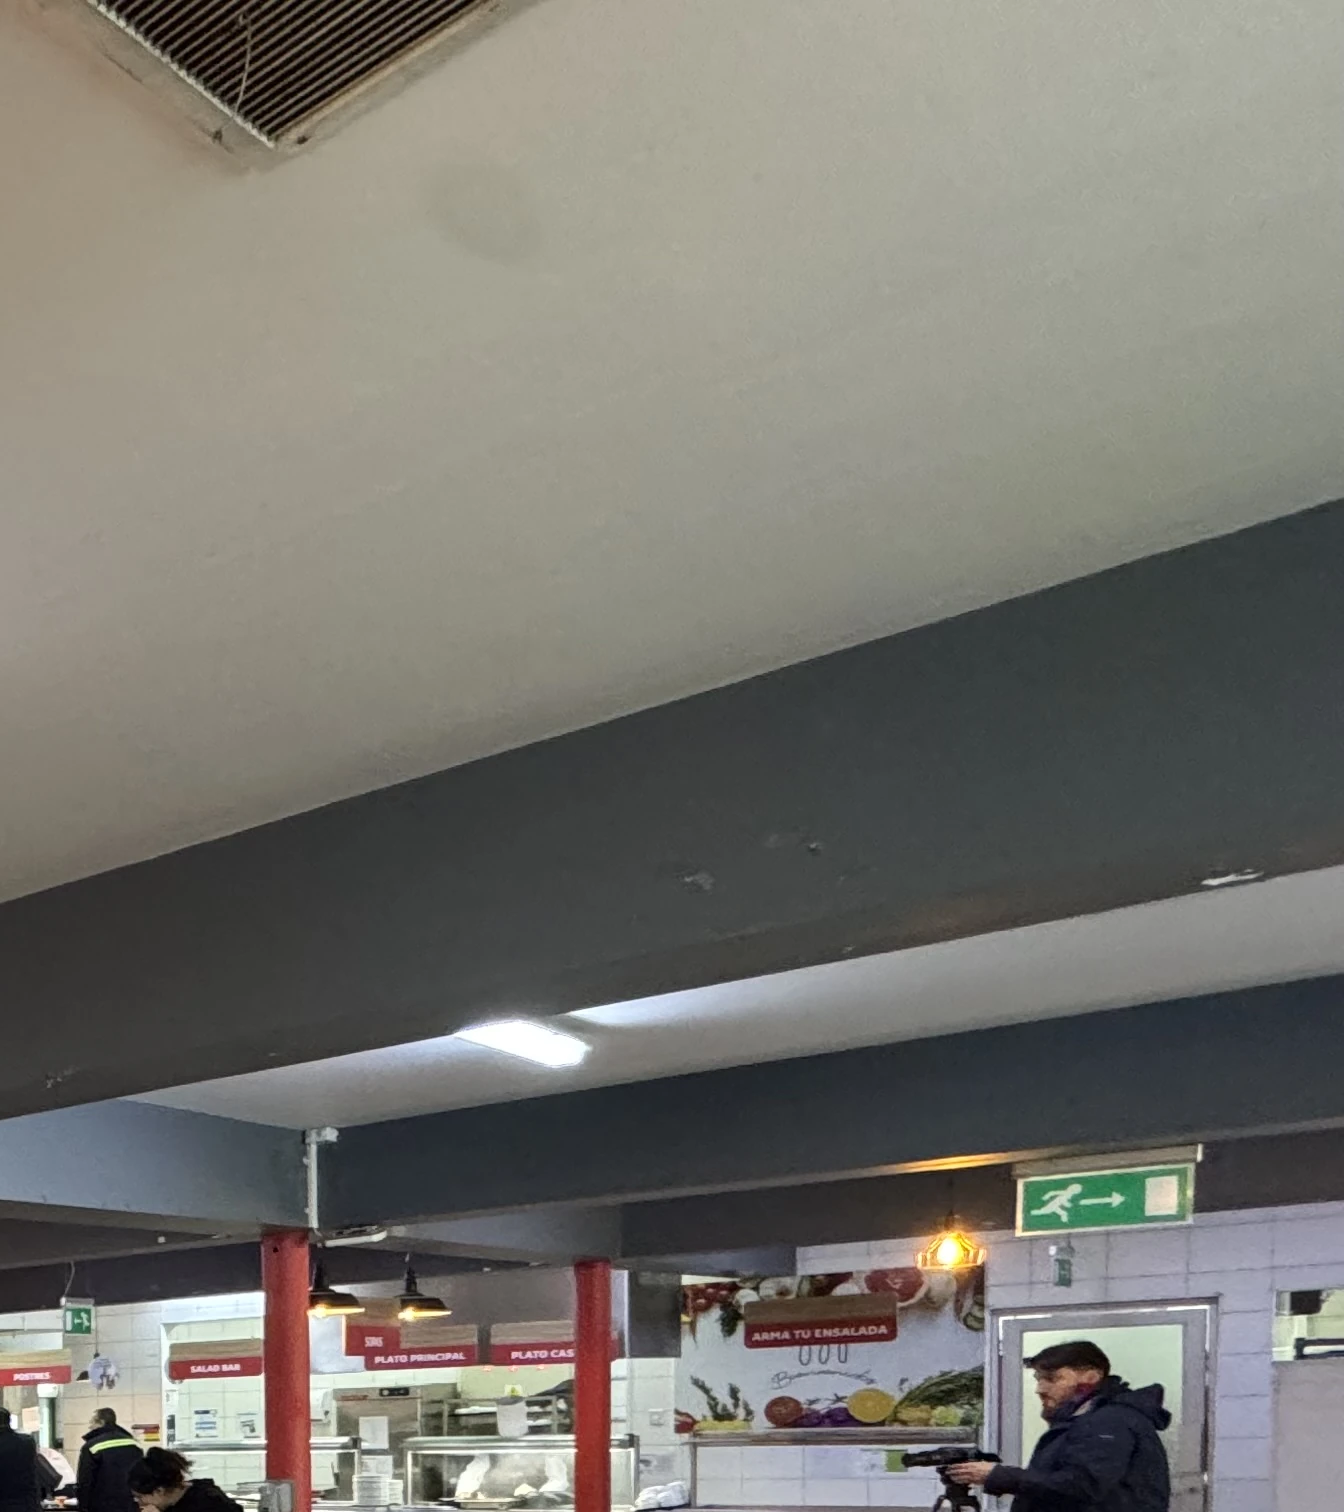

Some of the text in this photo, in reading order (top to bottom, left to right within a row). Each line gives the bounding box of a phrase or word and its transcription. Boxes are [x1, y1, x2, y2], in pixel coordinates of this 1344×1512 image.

[751, 1324, 889, 1342] ARMA TU ENSALADA
[374, 1352, 467, 1364] PLATO PRINCIPAL
[510, 1348, 575, 1360] PLATO CAS
[190, 1362, 241, 1374] SALAD BAR
[13, 1370, 51, 1381] POSTRES
